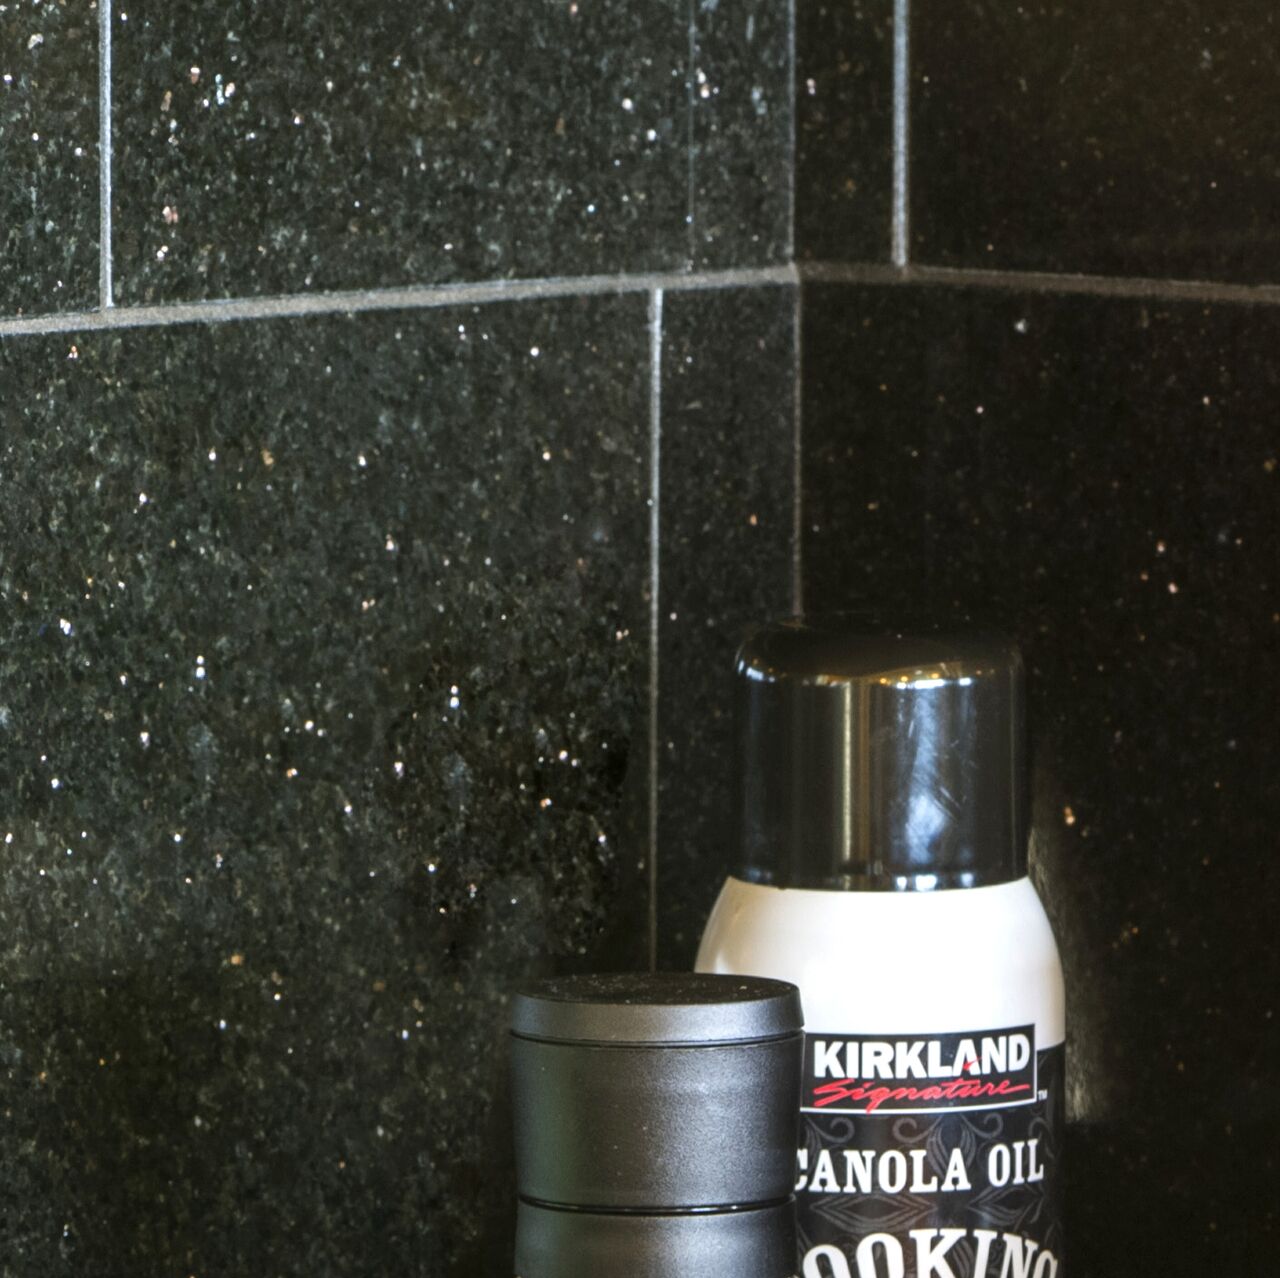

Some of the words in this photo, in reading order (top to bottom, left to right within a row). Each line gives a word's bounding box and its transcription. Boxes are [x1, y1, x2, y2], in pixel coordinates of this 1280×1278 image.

[814, 1034, 1030, 1079] KIRKLAND
[813, 1077, 1030, 1115] Signature
[988, 1138, 1044, 1188] OIL
